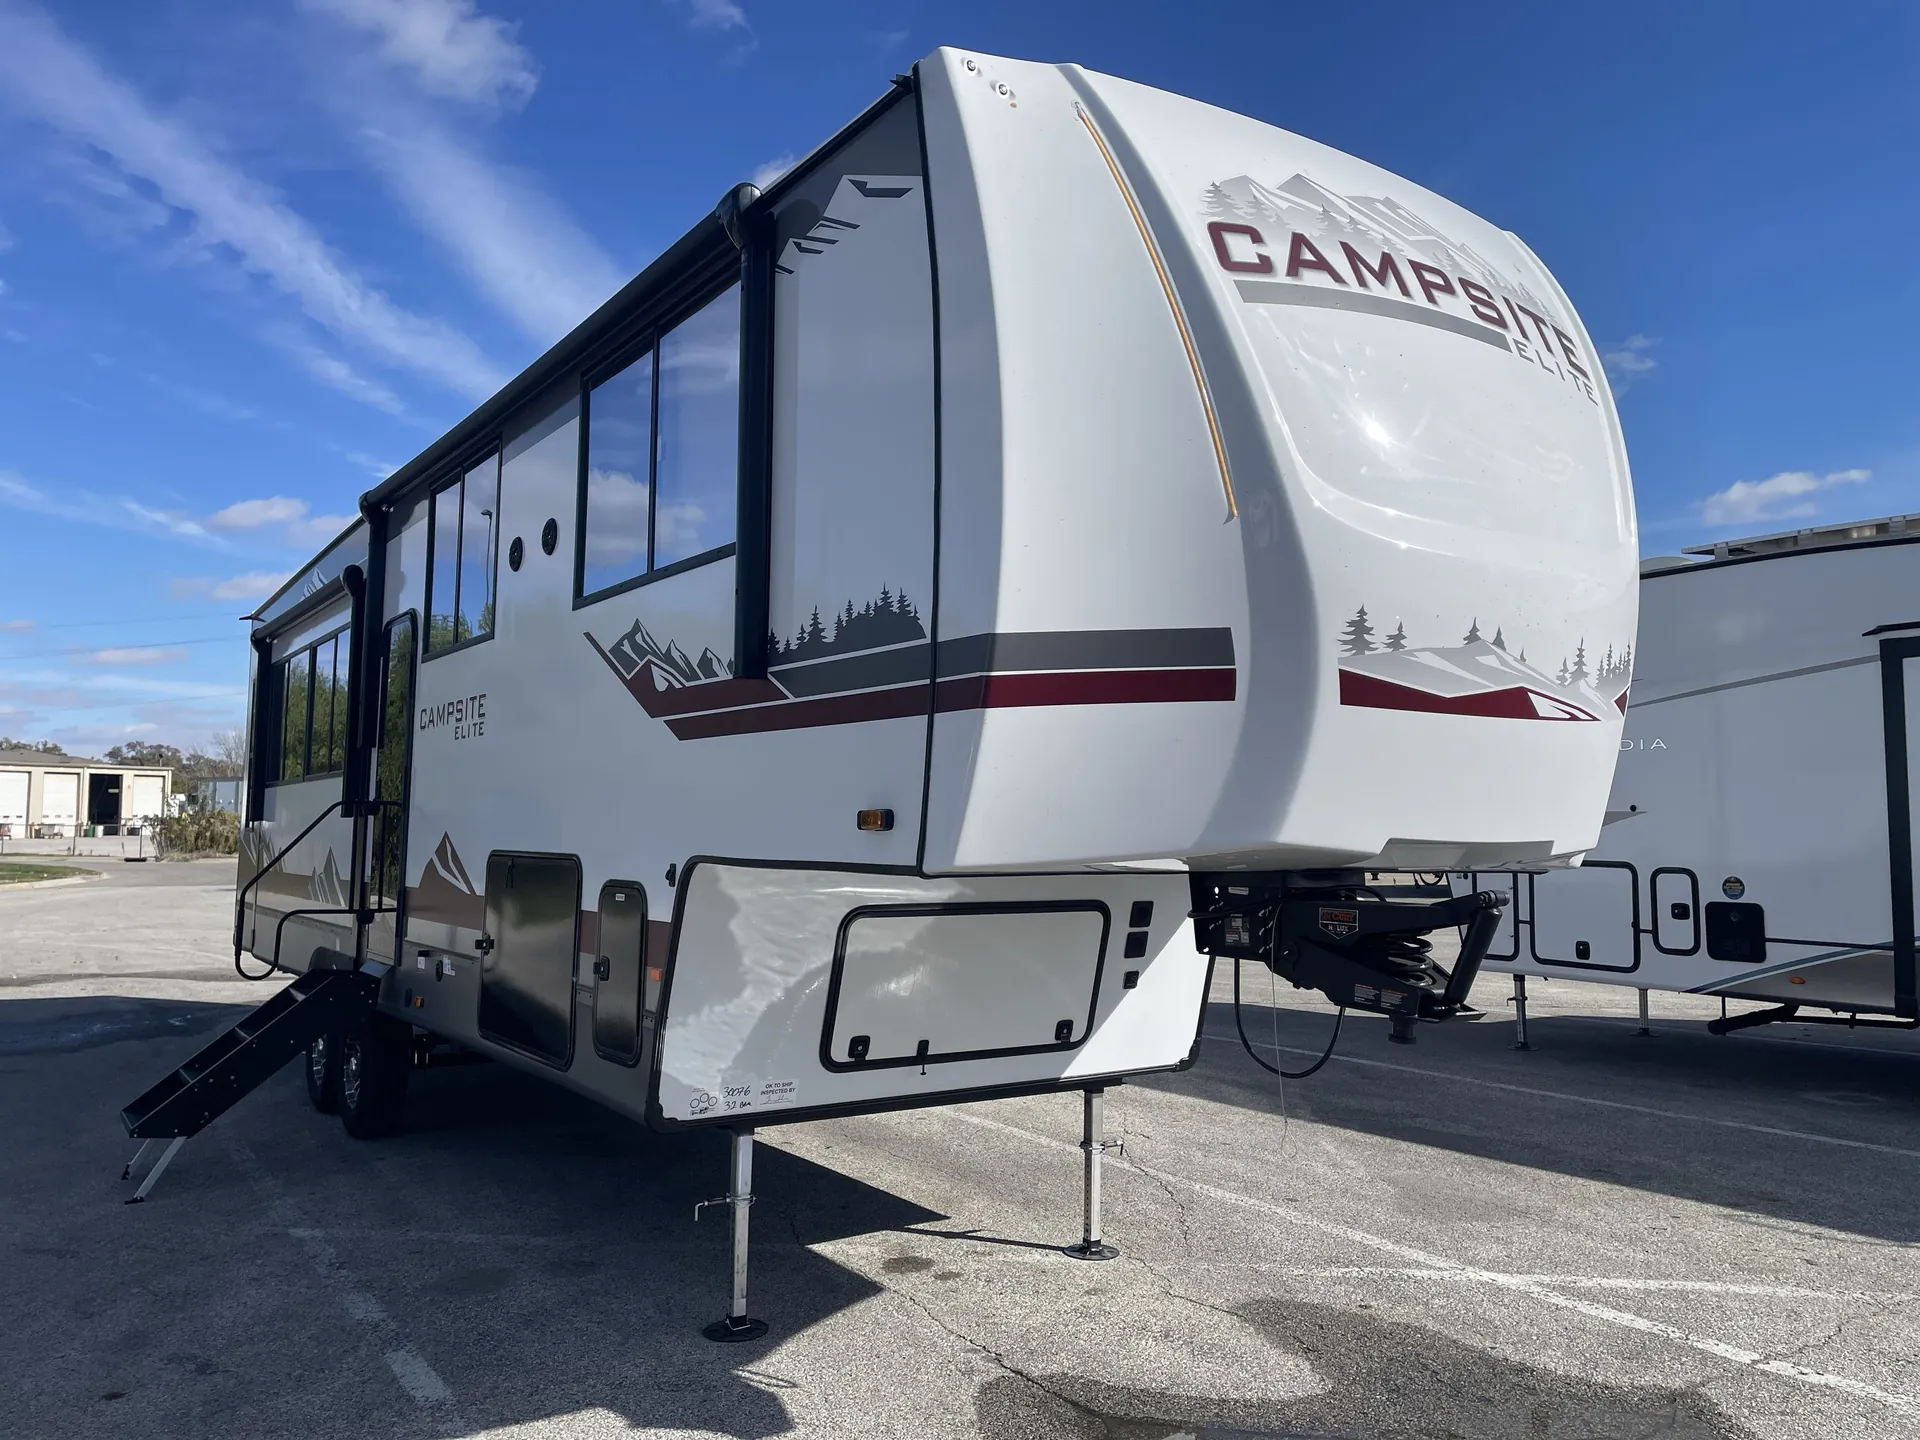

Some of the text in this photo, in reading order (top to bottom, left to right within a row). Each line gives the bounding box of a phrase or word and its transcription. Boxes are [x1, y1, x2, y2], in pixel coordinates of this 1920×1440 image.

[1206, 221, 1591, 380] CAMPSITE
[1512, 337, 1599, 407] ELITE
[420, 693, 487, 730] CAMPSITE
[454, 721, 485, 741] ELITE
[1619, 738, 1667, 750] DIA
[723, 1100, 737, 1112] 32
